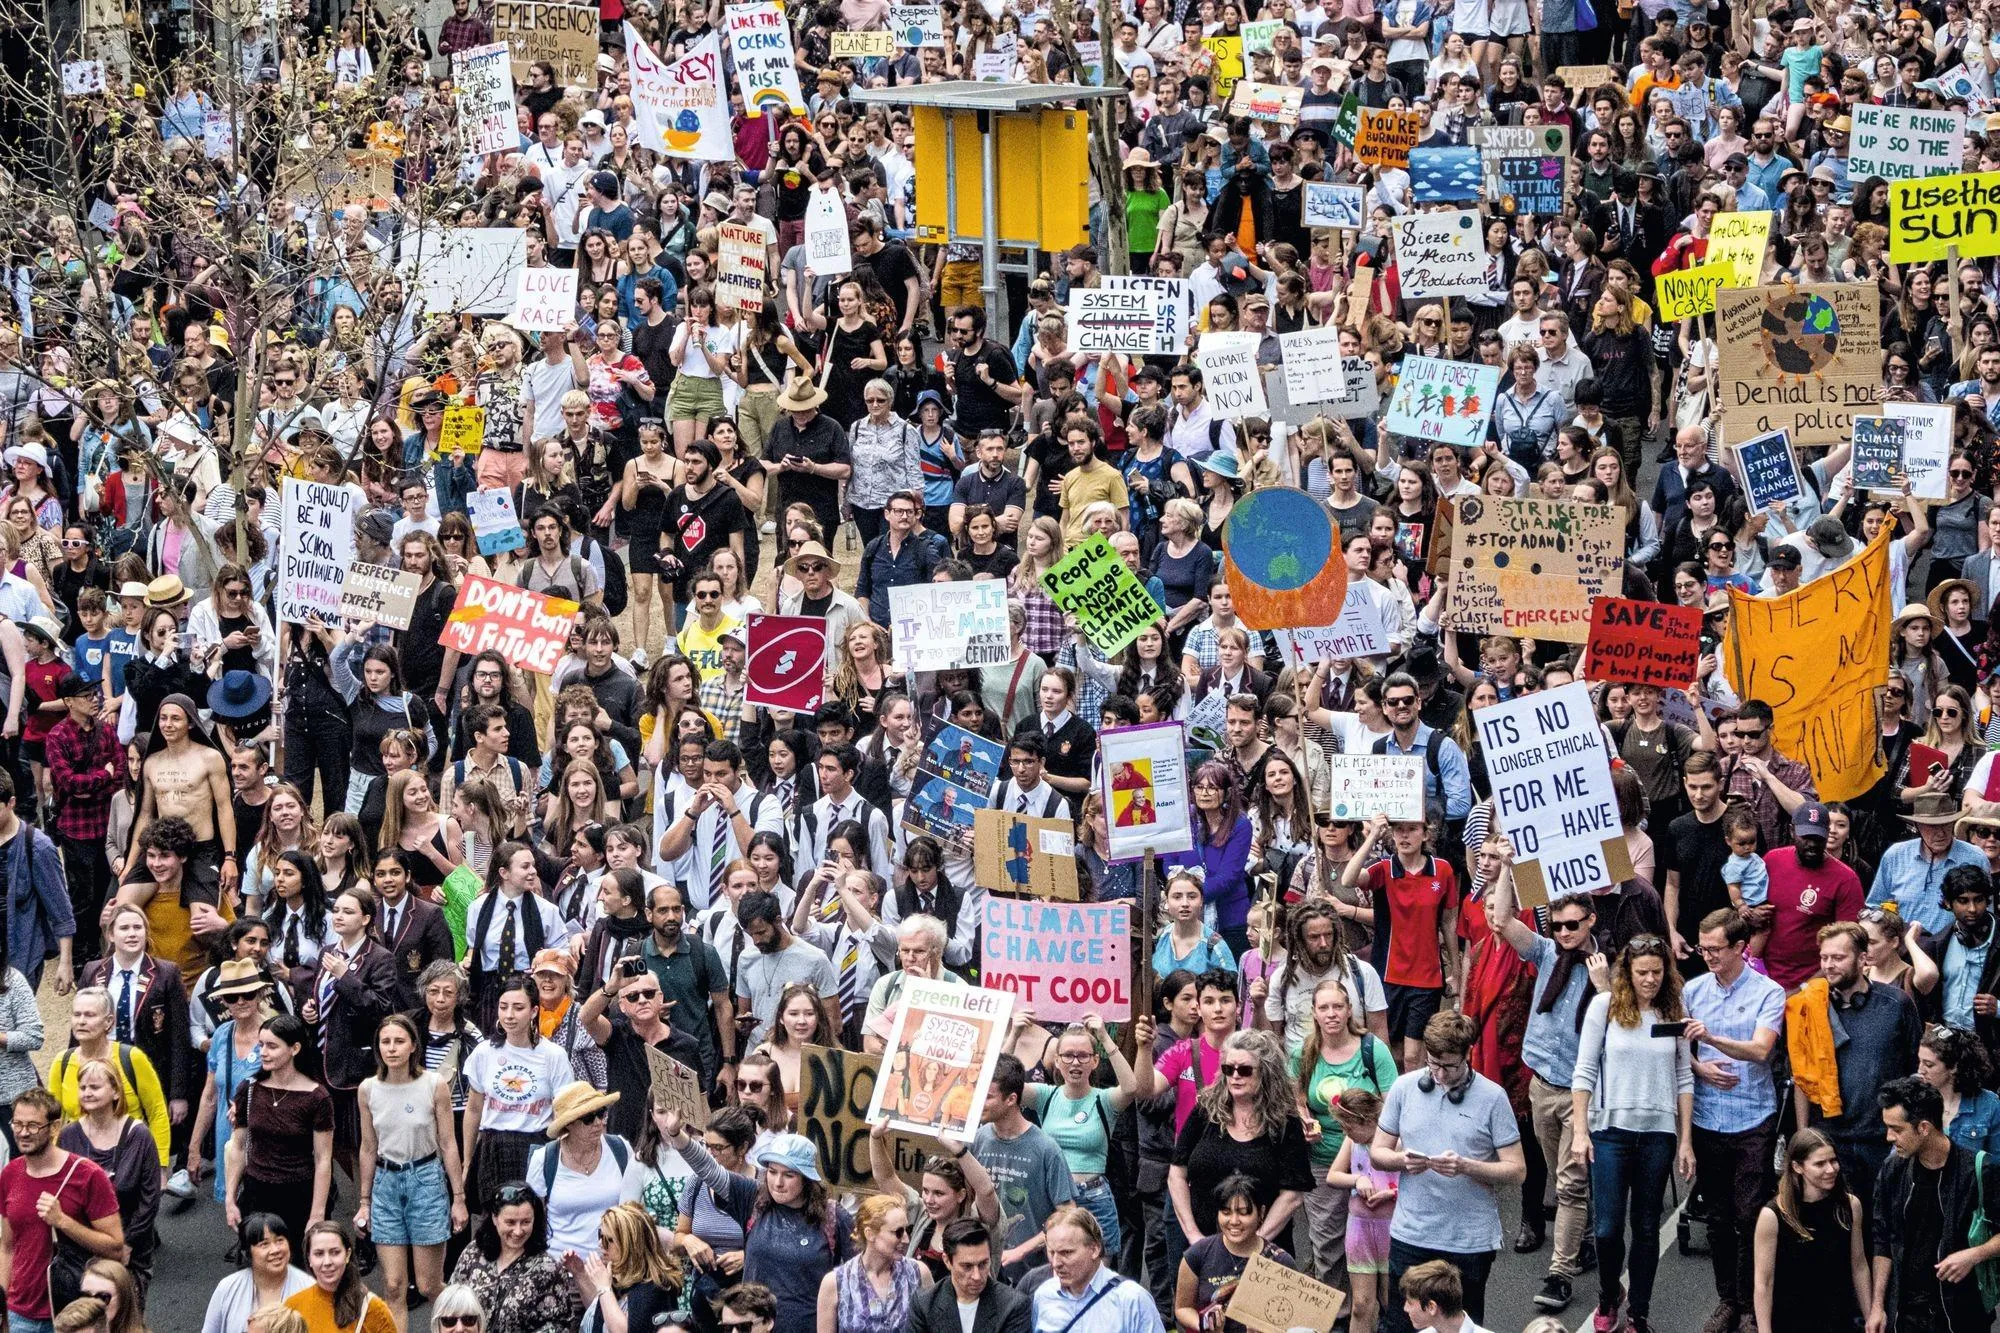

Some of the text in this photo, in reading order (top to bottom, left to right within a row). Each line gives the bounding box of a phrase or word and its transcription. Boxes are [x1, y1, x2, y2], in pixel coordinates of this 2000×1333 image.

[497, 3, 598, 36] EMERGENCY:
[731, 12, 781, 30] LIKE THE
[889, 7, 939, 18] Respect
[898, 17, 929, 27] Your
[738, 32, 786, 50] OCEANS
[834, 35, 895, 53] PLANET B
[513, 46, 583, 61] IMMEDIATE
[737, 56, 790, 72] WE WILL
[748, 71, 783, 88] RISE
[1367, 114, 1418, 134] YOU'RE
[1858, 109, 1956, 133] WE'RE RISING
[1366, 132, 1416, 146] BURNING
[1482, 128, 1535, 148] SKIPPED
[1859, 135, 1950, 156] UP SO THE
[1361, 145, 1378, 158] OUR
[1508, 149, 1531, 158] AREA
[1503, 160, 1539, 176] IT'S
[1849, 157, 1919, 178] SEA LEVEL
[1538, 196, 1562, 212] HERE
[721, 226, 762, 245] NATURE
[741, 256, 764, 270] FINAL
[1404, 248, 1476, 264] the Means
[526, 275, 572, 293] LOVE
[718, 271, 762, 291] WEATHER
[1401, 267, 1487, 287] of Production!
[540, 296, 548, 305] &
[740, 298, 762, 311] NOT
[1083, 293, 1145, 308] SYSTEM
[1833, 290, 1844, 303] In
[1721, 293, 1760, 321] Australia
[520, 308, 564, 326] RAGE
[1081, 311, 1151, 330] CLIMATE
[1739, 308, 1763, 328] should
[1080, 331, 1149, 348] CHANGE
[1284, 337, 1313, 348] UNLESS
[1840, 338, 1854, 347] What
[1206, 352, 1249, 368] CLIMATE
[1212, 371, 1248, 386] ACTION
[1406, 359, 1479, 386] RUN FOREST
[1215, 387, 1253, 411] NOW
[1736, 382, 1877, 405] Denial is not
[1421, 420, 1443, 437] RUN
[1757, 416, 1775, 432] a
[1855, 432, 1904, 445] CLIMATE
[1749, 452, 1787, 473] STRIKE
[1858, 447, 1899, 459] ACTION
[1761, 467, 1780, 481] FOR
[1865, 462, 1889, 471] NOW
[1752, 476, 1796, 497] CHANGE
[295, 483, 349, 512] I SHOULD
[298, 504, 331, 529] BE IN
[1502, 501, 1577, 520] STRIKE
[299, 531, 335, 561] SCHOOL
[1466, 533, 1517, 548] #STOP
[351, 562, 399, 582] RESPECT
[1044, 544, 1108, 593] People
[1458, 572, 1474, 582] I'm
[351, 577, 413, 598] EXISTENCE
[371, 591, 381, 600] OR
[1457, 583, 1497, 598] Missing
[342, 592, 385, 612] EXPECT
[931, 585, 1004, 612] LOVE IT
[1085, 585, 1119, 616] NOT
[1453, 595, 1469, 611] My
[341, 604, 407, 627] RESISTANCE
[1081, 583, 1144, 637] CLIMATE
[1602, 602, 1667, 631] SAVE
[898, 611, 1006, 642] IF WE MADE
[1097, 597, 1157, 650] CHANGE
[1322, 627, 1336, 637] OF
[1349, 622, 1371, 634] THE
[477, 622, 562, 671] FUTURE
[968, 634, 1003, 645] NEXT
[1314, 633, 1376, 657] PRIMATE
[1592, 640, 1635, 658] GOOD
[966, 645, 1011, 664] CENTURY
[1748, 655, 1795, 708] IS
[1483, 701, 1570, 750] ITS NO
[1334, 757, 1348, 768] WE
[1353, 757, 1387, 768] MIGHT
[1492, 732, 1599, 775] LONGER ETHICAL
[926, 755, 938, 765] Am
[942, 763, 954, 773] out
[955, 769, 963, 777] of
[963, 773, 987, 787] touch?
[1499, 767, 1589, 817] FOR ME
[1156, 799, 1175, 808] Adani
[1355, 801, 1405, 817] PLANETS
[1508, 802, 1614, 857] TO HAVE
[1548, 854, 1601, 892] KIDS
[986, 901, 1126, 935] CLIMATE
[984, 972, 1129, 1005] NOT COOL
[910, 989, 961, 1008] green
[928, 1016, 974, 1041] SYSTEM
[924, 1031, 968, 1052] CHANGE
[926, 1044, 956, 1061] NOW
[1256, 1257, 1336, 1299] WE ARE RUNNING
[1248, 1271, 1276, 1285] OUT
[1277, 1281, 1297, 1293] OF
[1298, 1290, 1331, 1311] TIME!
